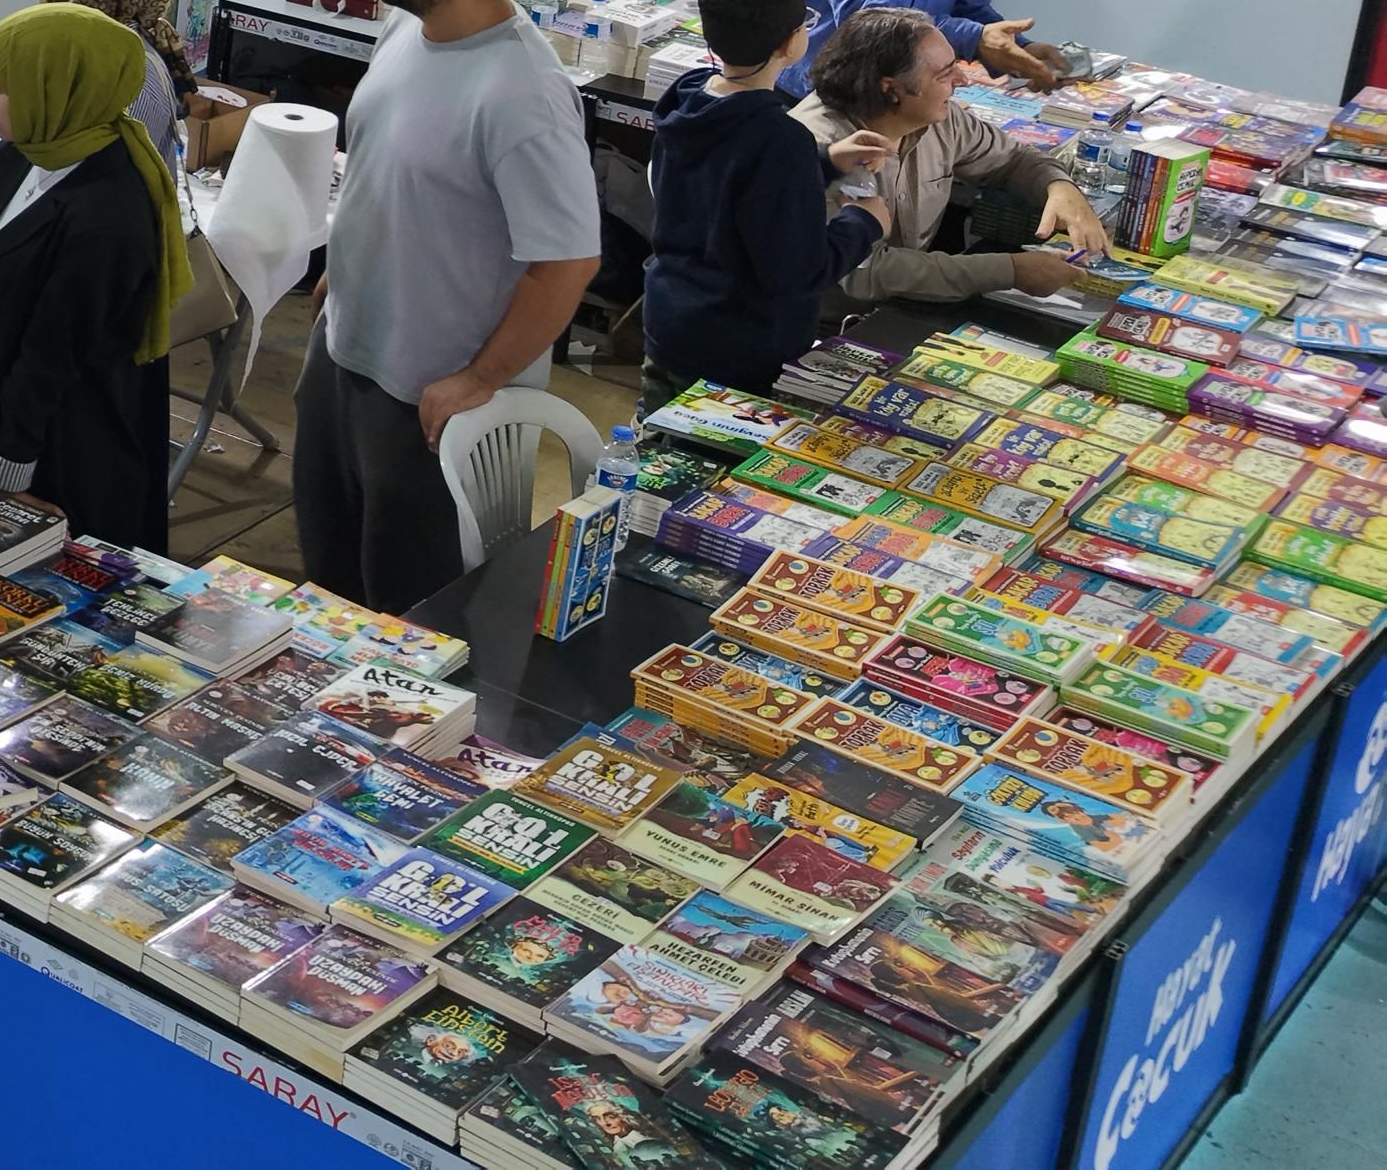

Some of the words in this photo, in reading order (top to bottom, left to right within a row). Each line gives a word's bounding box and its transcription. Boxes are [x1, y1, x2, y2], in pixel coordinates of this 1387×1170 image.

[709, 421, 771, 442] Sevginin
[799, 567, 836, 599] TOPRAK
[761, 606, 801, 634] TOPRAK
[685, 663, 730, 692] TOPRAK
[839, 719, 887, 751] TOPRAK
[1041, 738, 1090, 774] TOPRAK
[374, 769, 444, 808] HAYALET
[374, 789, 414, 811] GEMİ
[550, 776, 635, 813] SENSİN
[457, 828, 541, 870] SENSİN
[645, 829, 689, 854] YUNUS
[691, 849, 727, 870] EMRE
[570, 893, 620, 919] CEZERİ
[747, 879, 798, 905] MİMAR
[800, 901, 840, 925] SİNAN
[209, 913, 285, 952] UZAYDAKİ
[309, 955, 388, 995] UZAYDAKİ
[649, 943, 702, 969] AHMET
[691, 962, 747, 986] ÇELEBİ
[667, 941, 739, 974] HEZARFEN
[307, 966, 368, 996] DÜŞMAN
[420, 1008, 505, 1055] Einstein
[440, 1002, 509, 1042] Albert
[222, 1050, 351, 1131] SARAY
